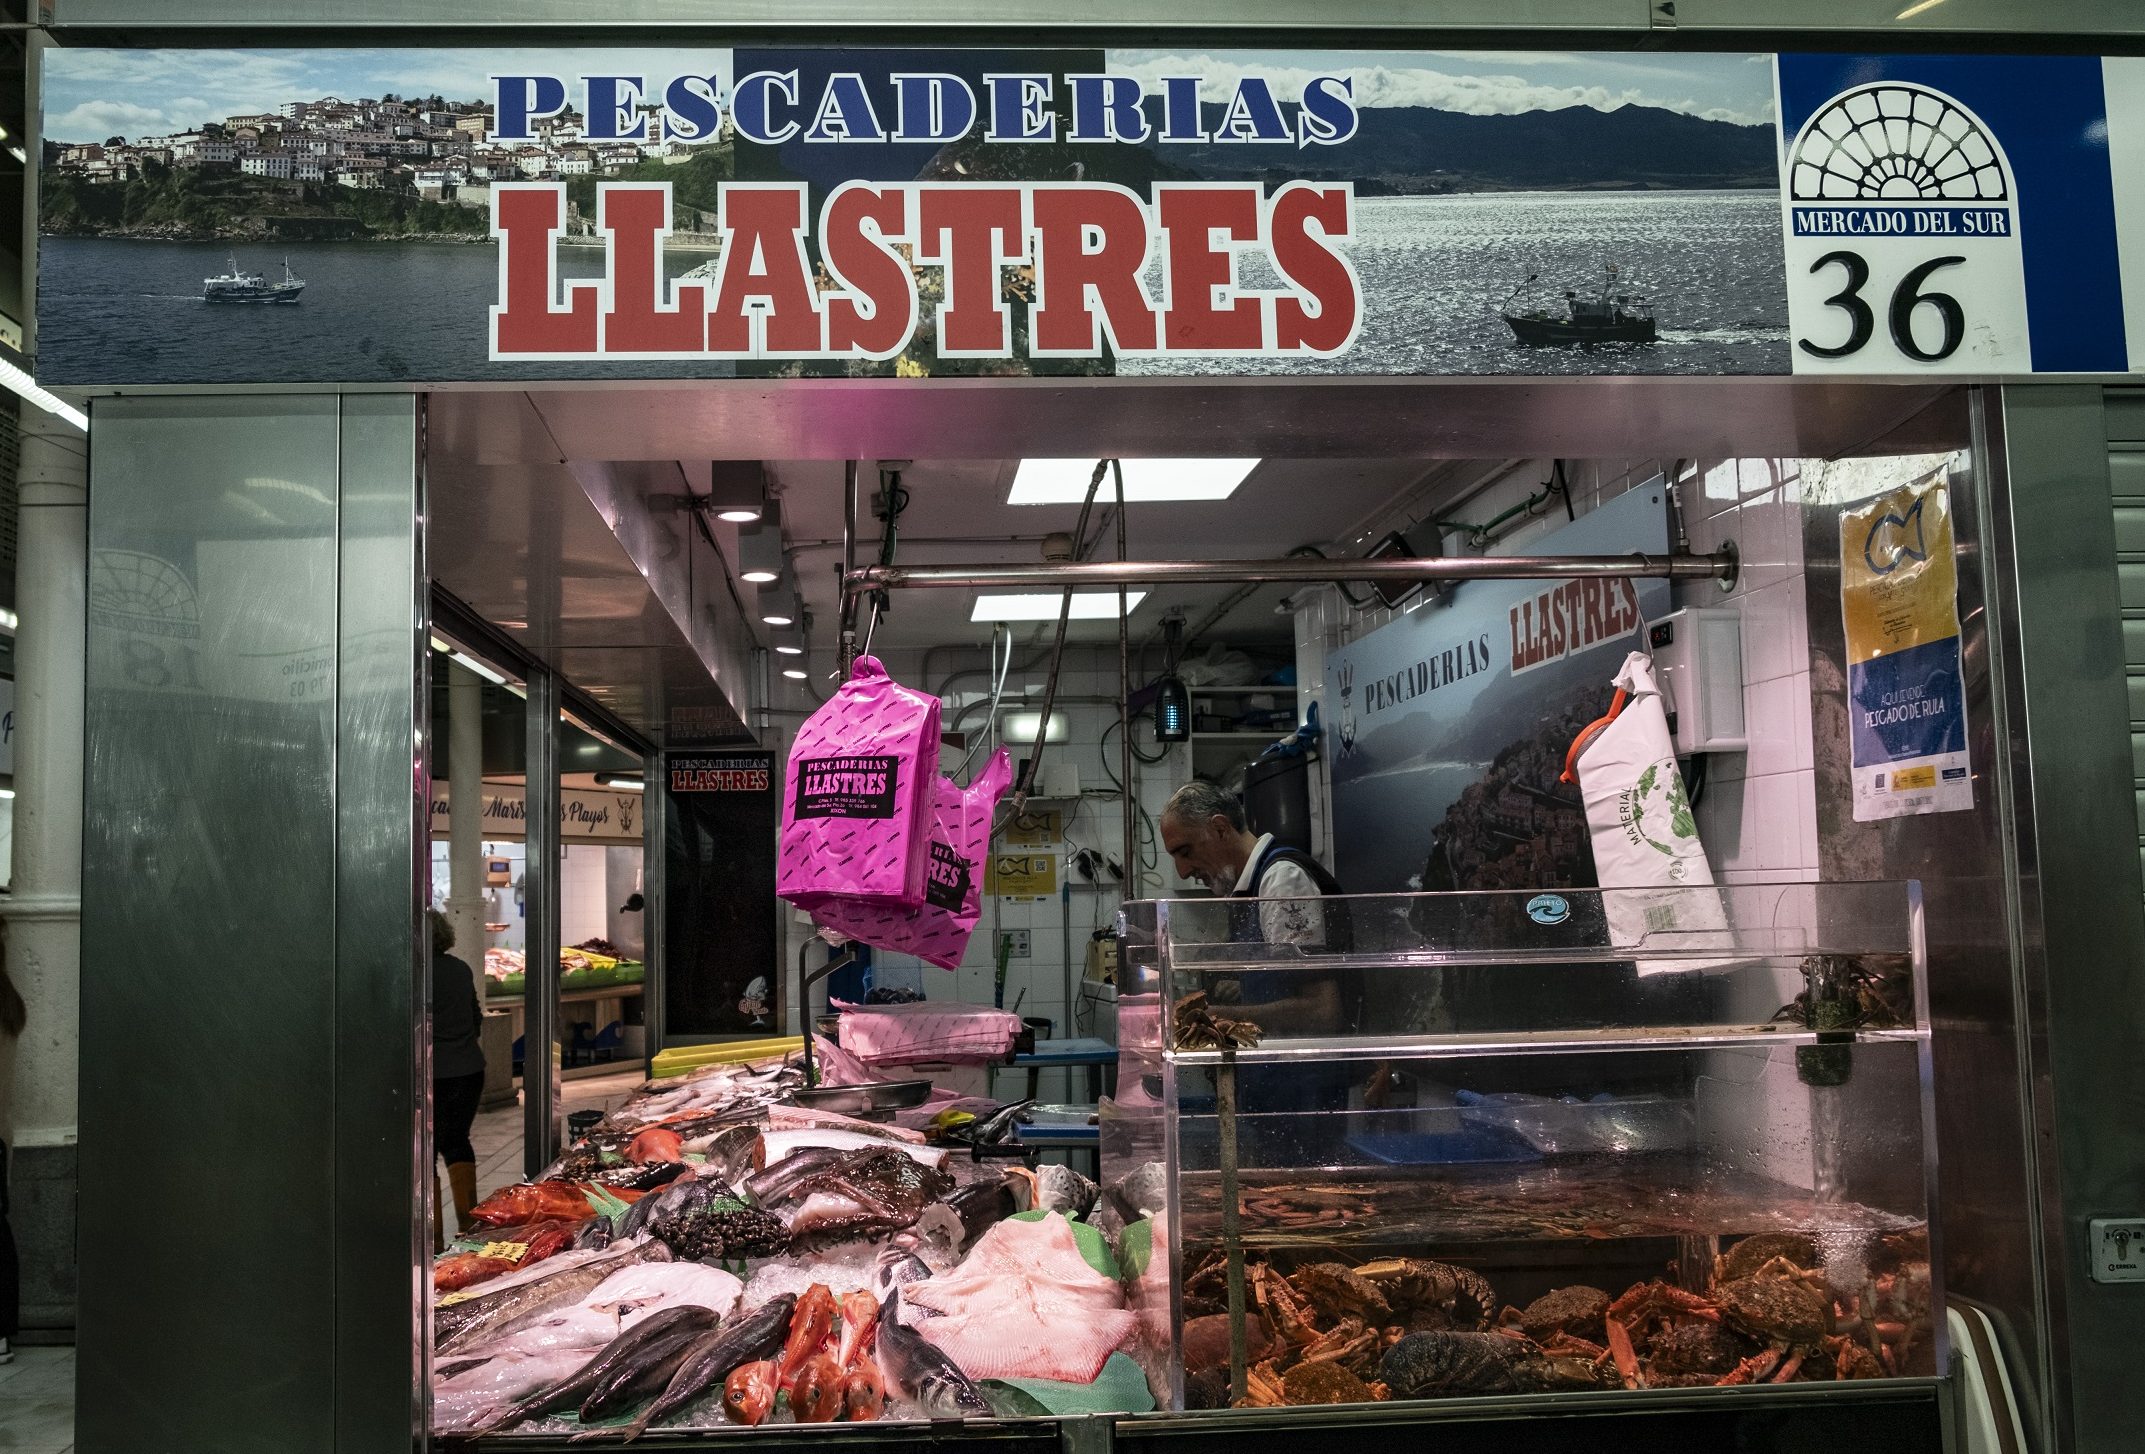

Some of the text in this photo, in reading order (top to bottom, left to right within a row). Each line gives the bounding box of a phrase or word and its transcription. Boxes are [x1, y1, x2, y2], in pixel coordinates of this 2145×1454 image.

[487, 70, 1361, 149] PESCADERIAS
[1797, 211, 2008, 234] MERCADO DEL SUR
[488, 179, 1364, 361] LLASTRES
[1798, 250, 1967, 363] 36
[1509, 577, 1639, 676] LLASTRES
[1365, 632, 1490, 714] PESCADERIAS
[1865, 697, 1945, 728] PESCADO DE RULA
[671, 759, 769, 769] PESCADERIAS
[671, 769, 769, 791] LLASTRES
[807, 760, 889, 773] PESCADERIAS
[804, 773, 887, 796] LLASTRES
[483, 796, 526, 819] Maris
[569, 801, 610, 833] Playos
[1620, 787, 1642, 846] MATERIAL
